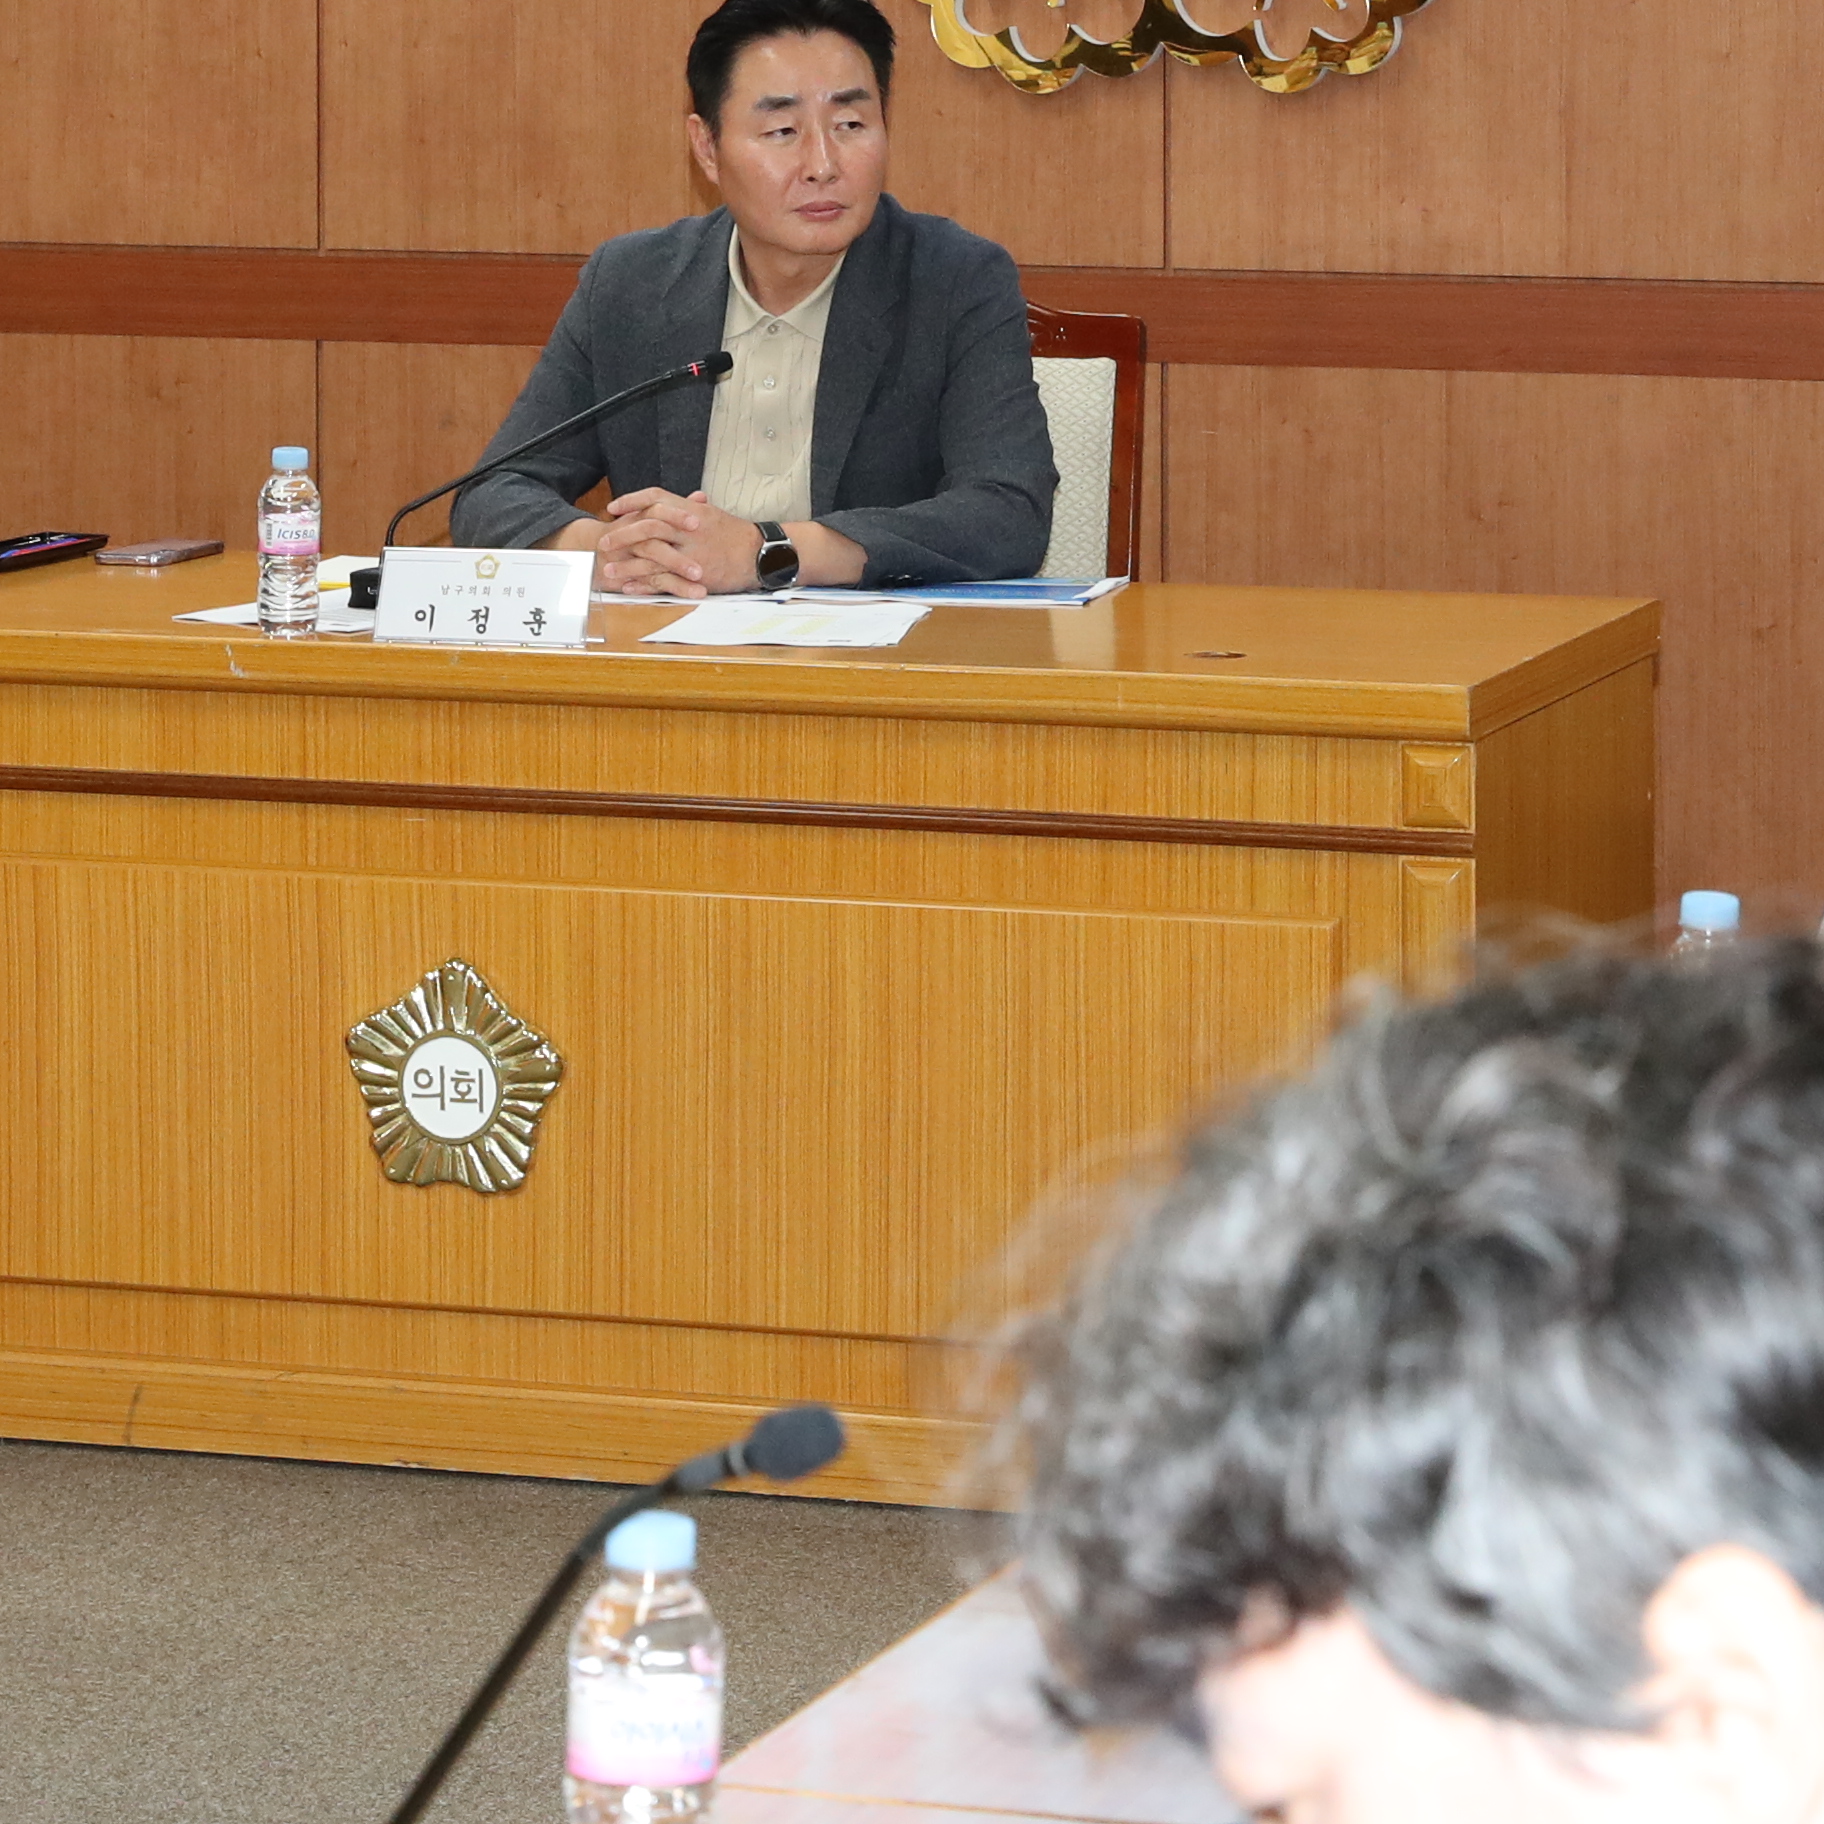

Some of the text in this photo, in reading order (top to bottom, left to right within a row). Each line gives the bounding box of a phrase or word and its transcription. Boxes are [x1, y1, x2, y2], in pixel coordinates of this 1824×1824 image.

[441, 584, 526, 599] 남구의회 의원
[412, 1065, 484, 1114] 의회
